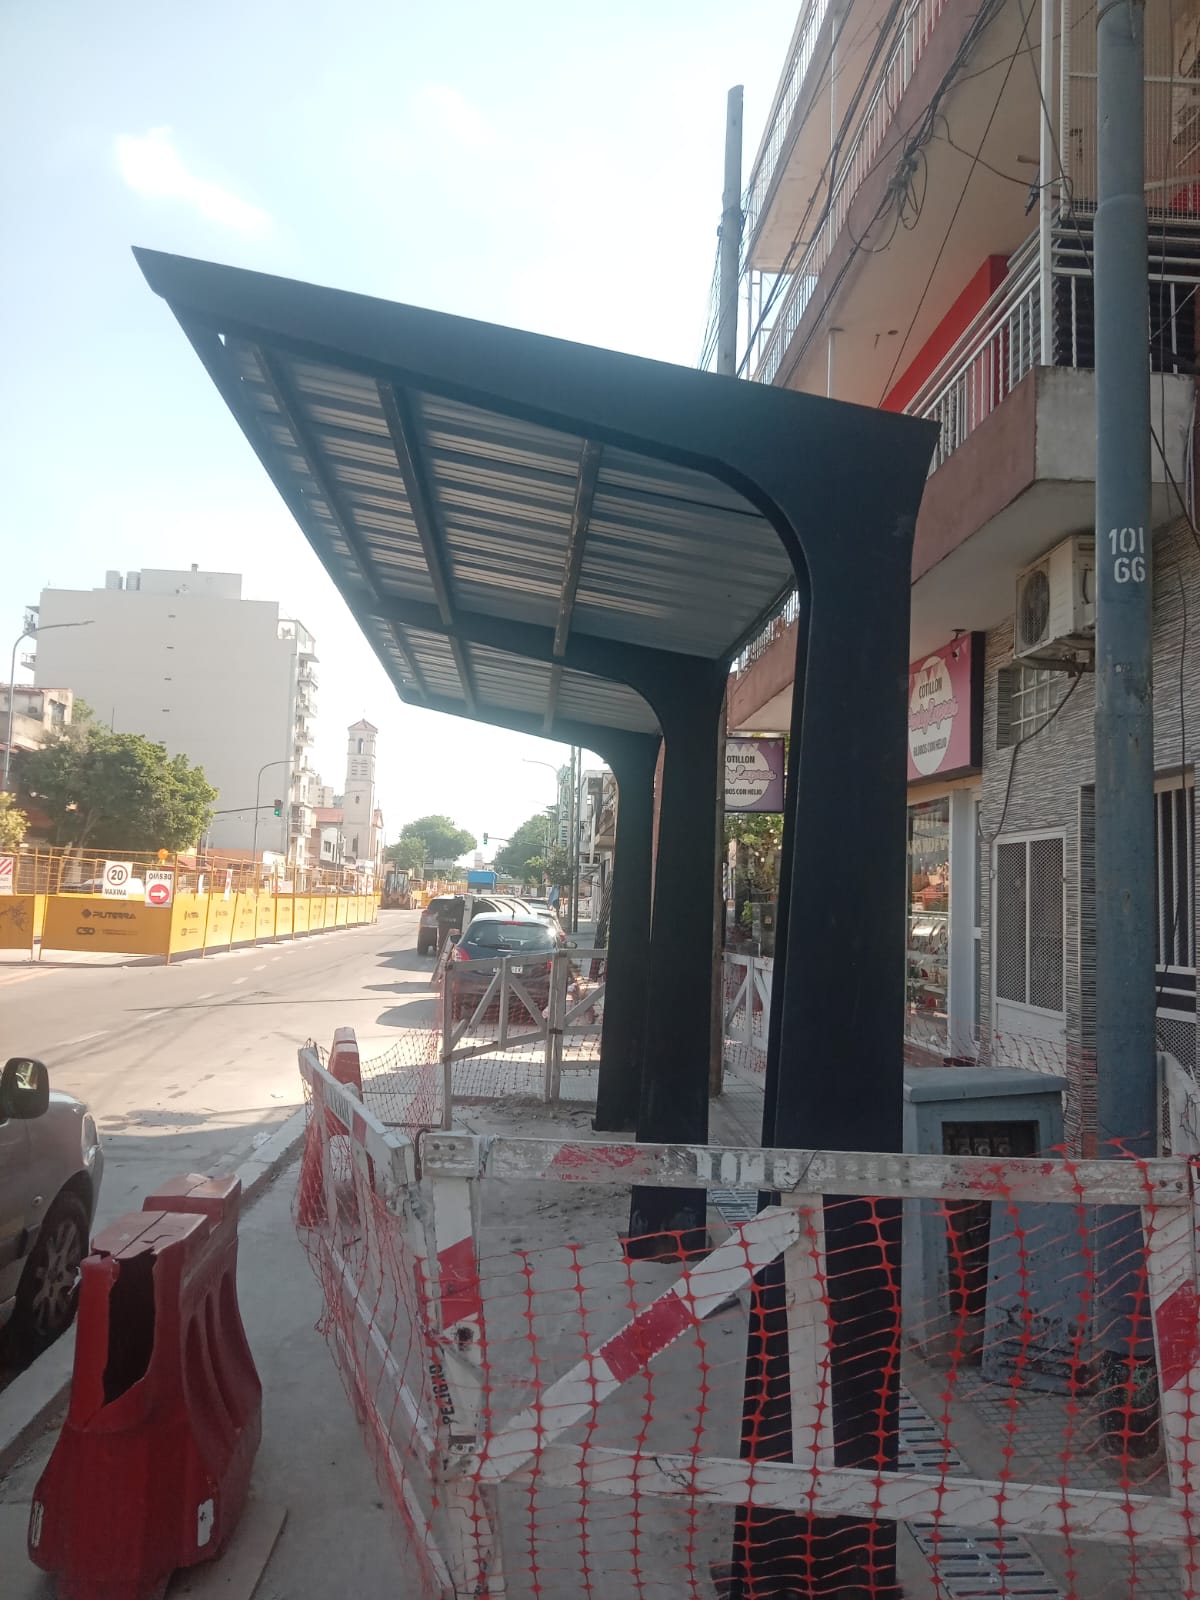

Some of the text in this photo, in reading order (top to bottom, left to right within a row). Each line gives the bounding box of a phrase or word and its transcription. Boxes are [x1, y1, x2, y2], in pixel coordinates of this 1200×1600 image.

[1108, 527, 1145, 555] 101
[1114, 556, 1146, 584] 66
[919, 677, 943, 699] COTILLON
[726, 755, 756, 764] OTILLON
[110, 869, 124, 881] 20
